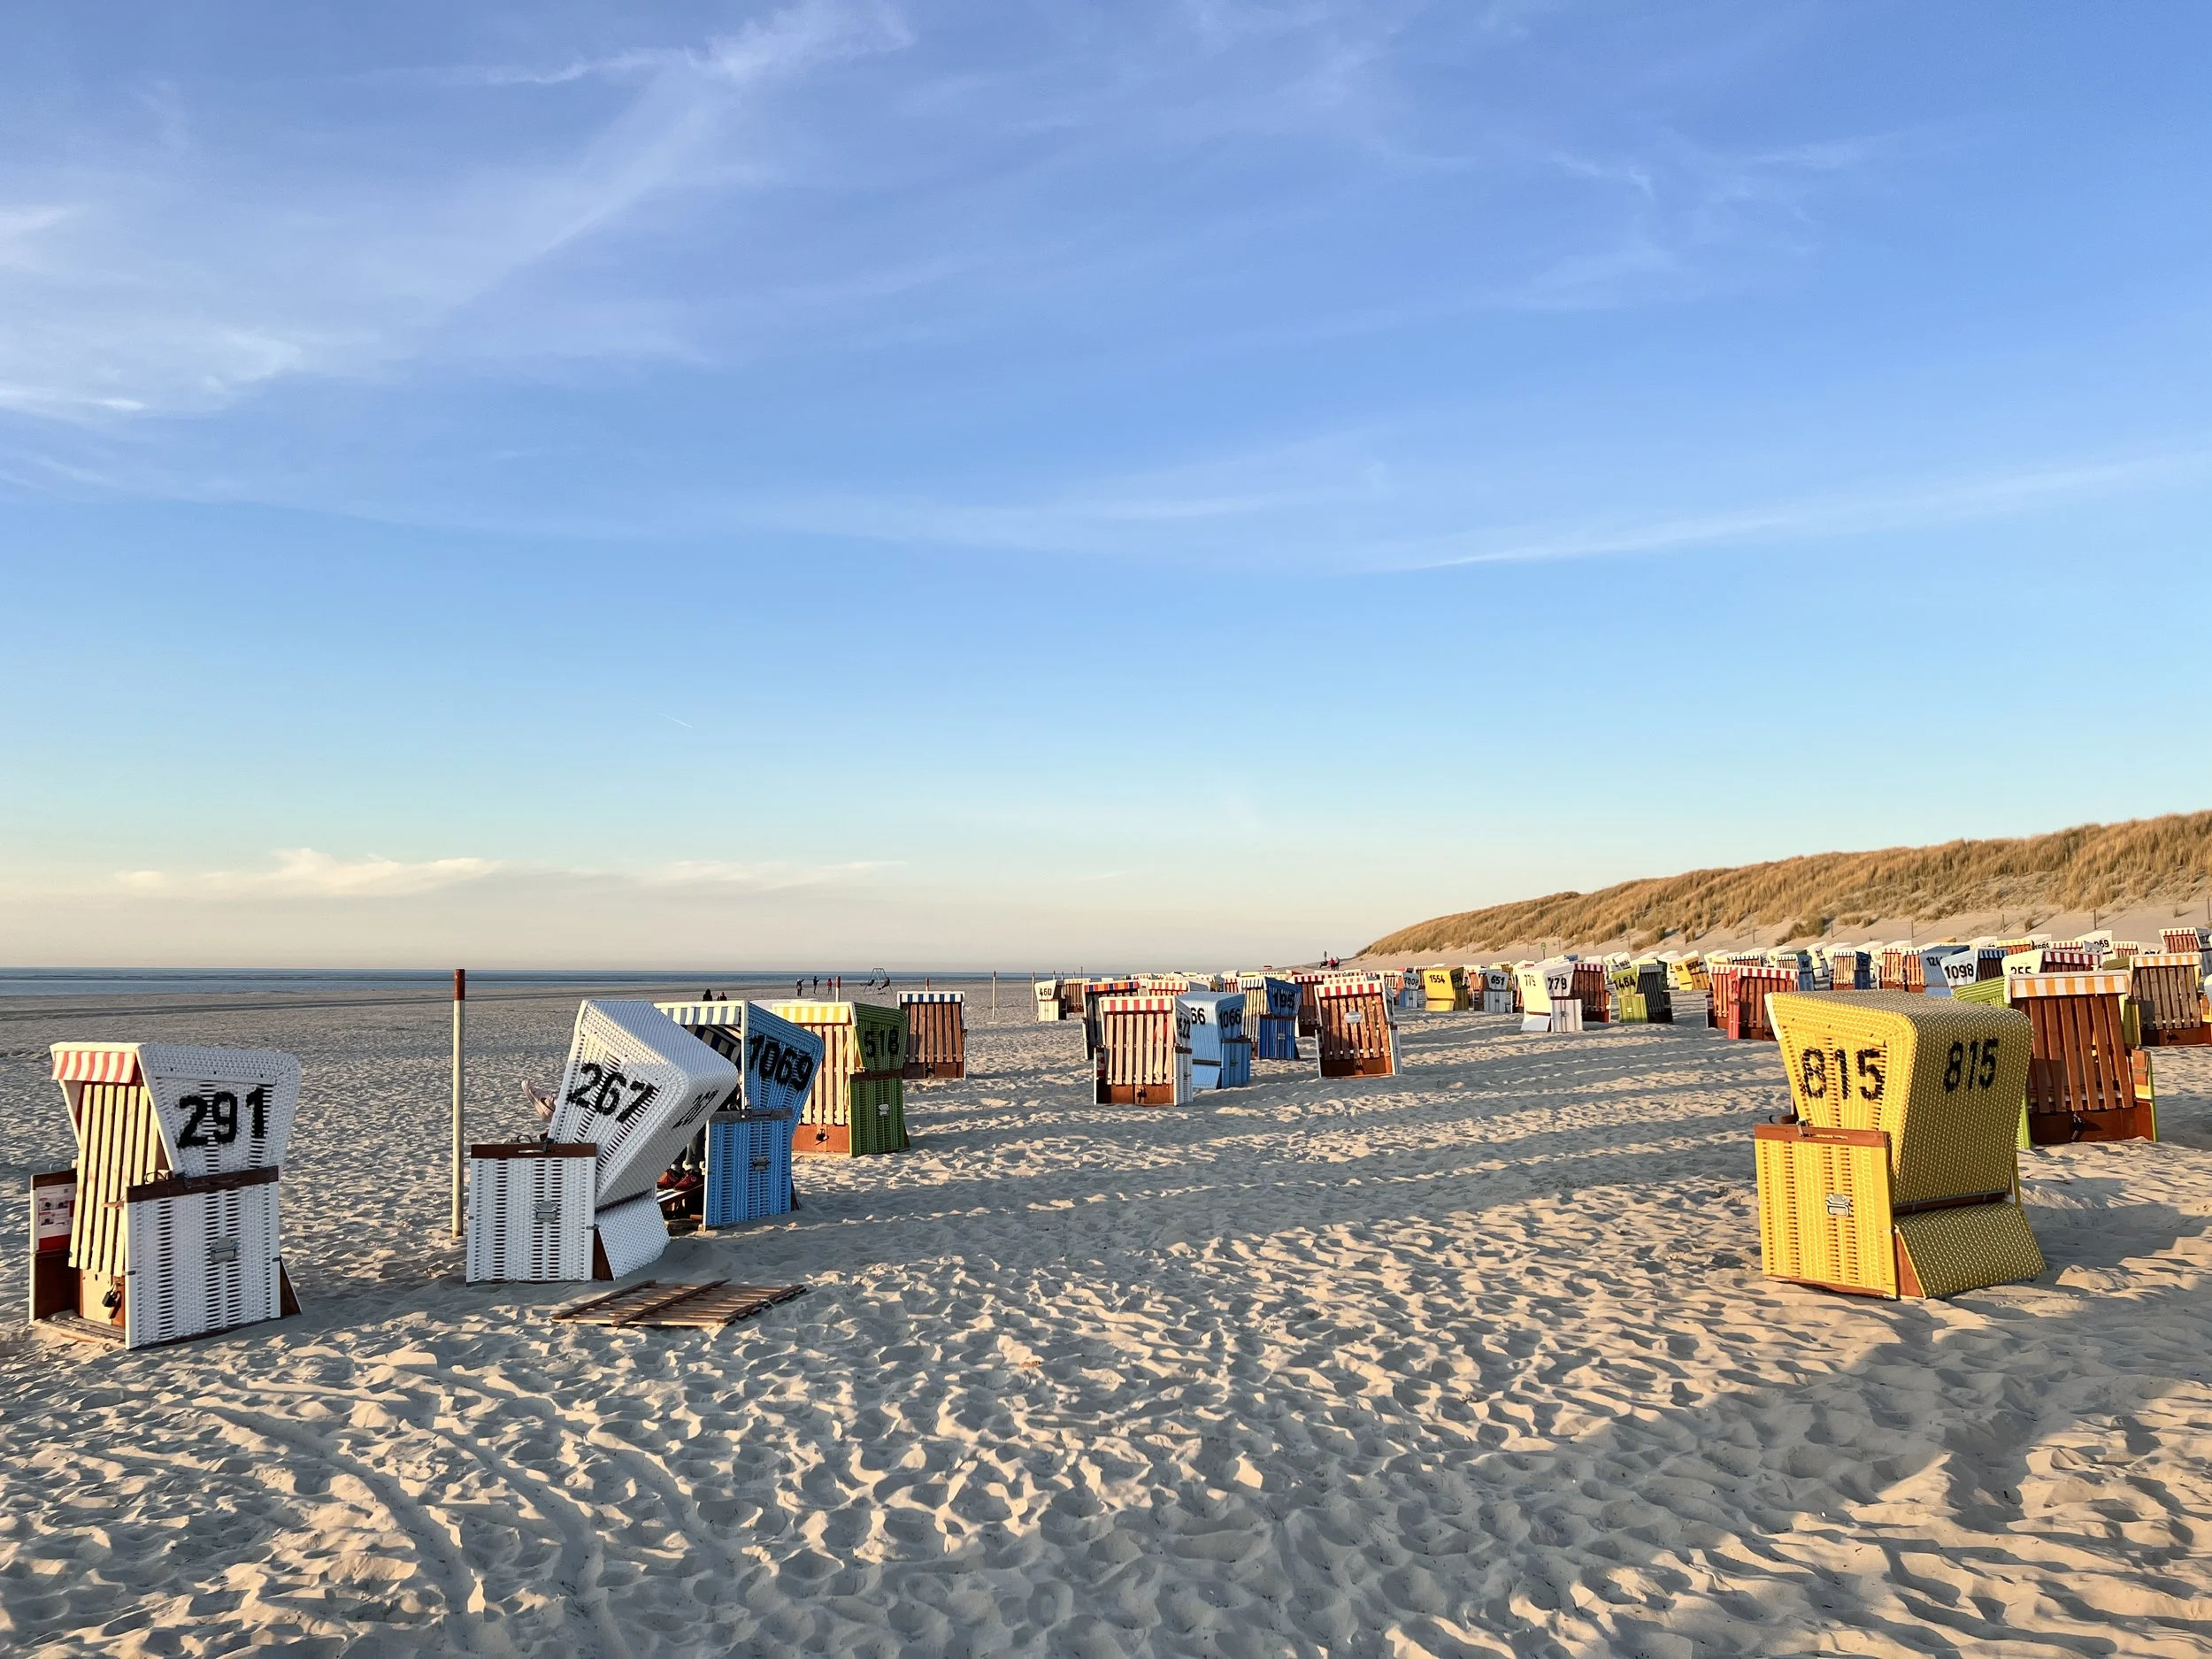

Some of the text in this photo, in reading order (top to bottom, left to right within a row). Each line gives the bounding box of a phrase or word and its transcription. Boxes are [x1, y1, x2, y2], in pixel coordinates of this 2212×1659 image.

[1429, 974, 1445, 984] 1554
[1490, 975, 1505, 986] 651
[1524, 974, 1536, 987] 779
[1944, 964, 1974, 979] 1098
[1039, 987, 1052, 996] 460
[1548, 977, 1567, 990] 779
[1613, 976, 1636, 990] 1464
[1190, 1007, 1206, 1025] 66
[1219, 1008, 1242, 1029] 1066
[864, 1025, 899, 1057] 518
[749, 1033, 814, 1090] 1069
[1943, 1038, 1999, 1092] 815
[1801, 1047, 1885, 1101] 815
[566, 1063, 660, 1124] 267
[176, 1087, 266, 1149] 291
